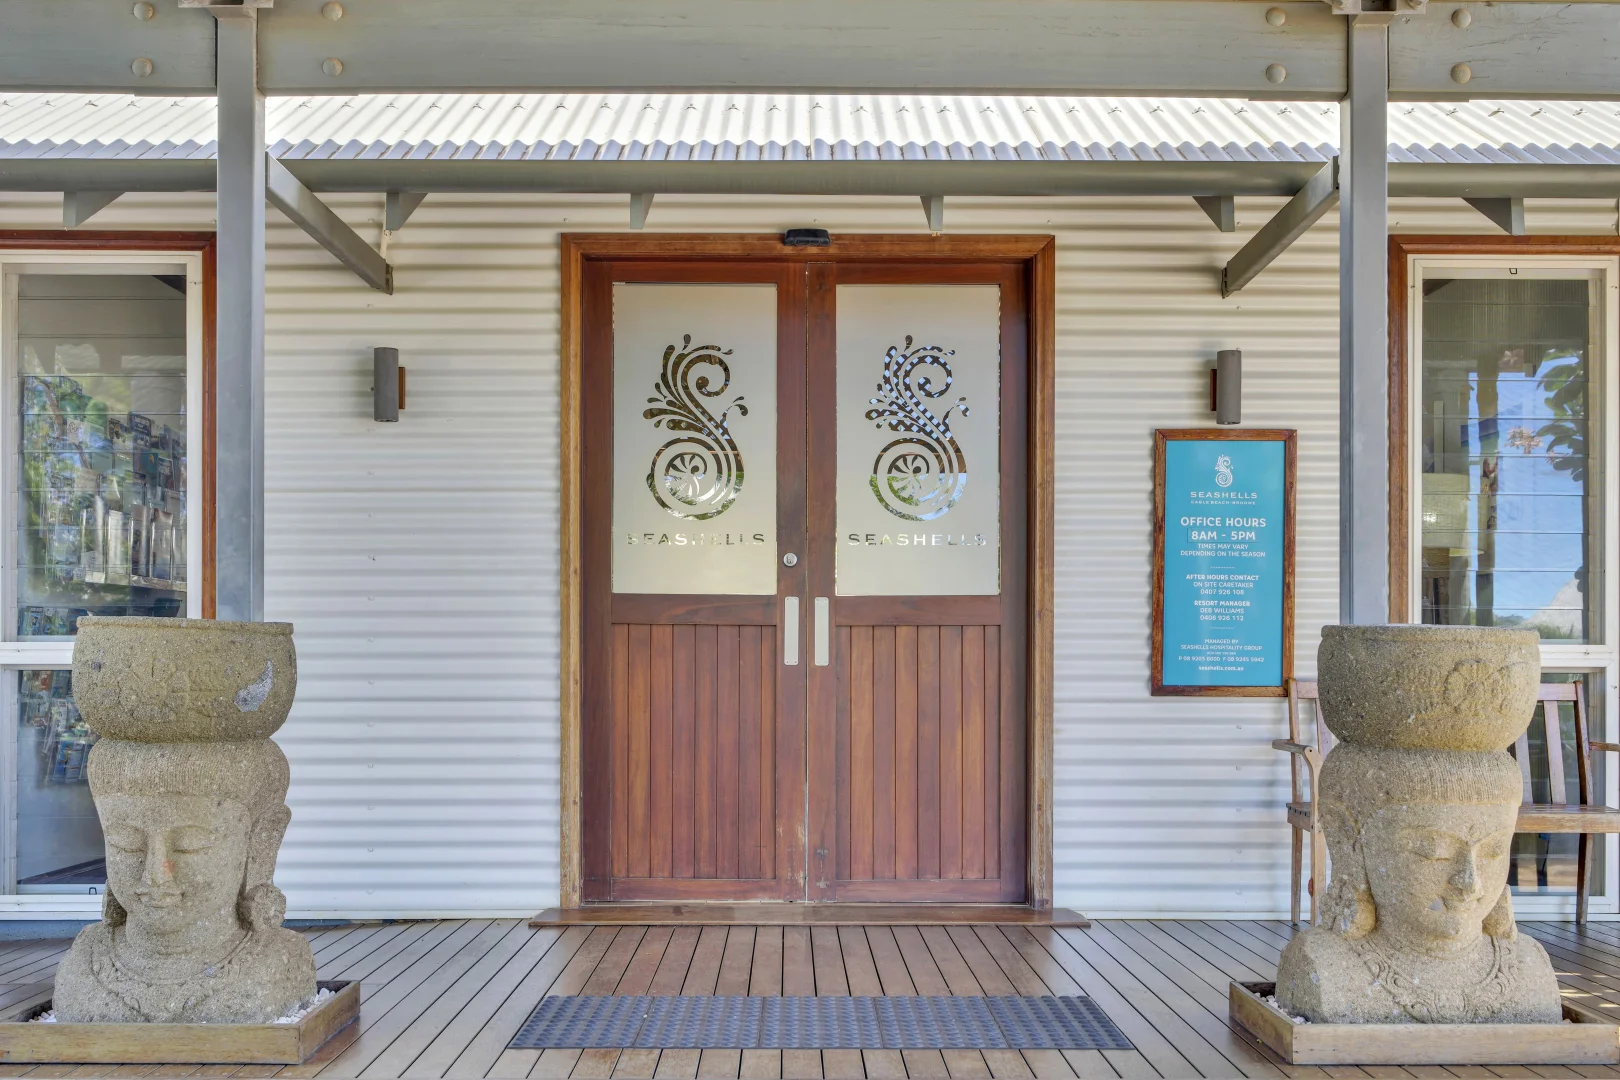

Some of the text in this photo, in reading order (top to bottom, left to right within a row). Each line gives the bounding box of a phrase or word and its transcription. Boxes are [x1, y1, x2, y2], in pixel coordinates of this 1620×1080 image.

[1181, 517, 1266, 527] OFFICE HOURS
[627, 533, 764, 546] SEASHELLS
[848, 534, 986, 546] SEASHELLS
[1191, 531, 1217, 540] 8AM
[1231, 532, 1256, 540] 5PM
